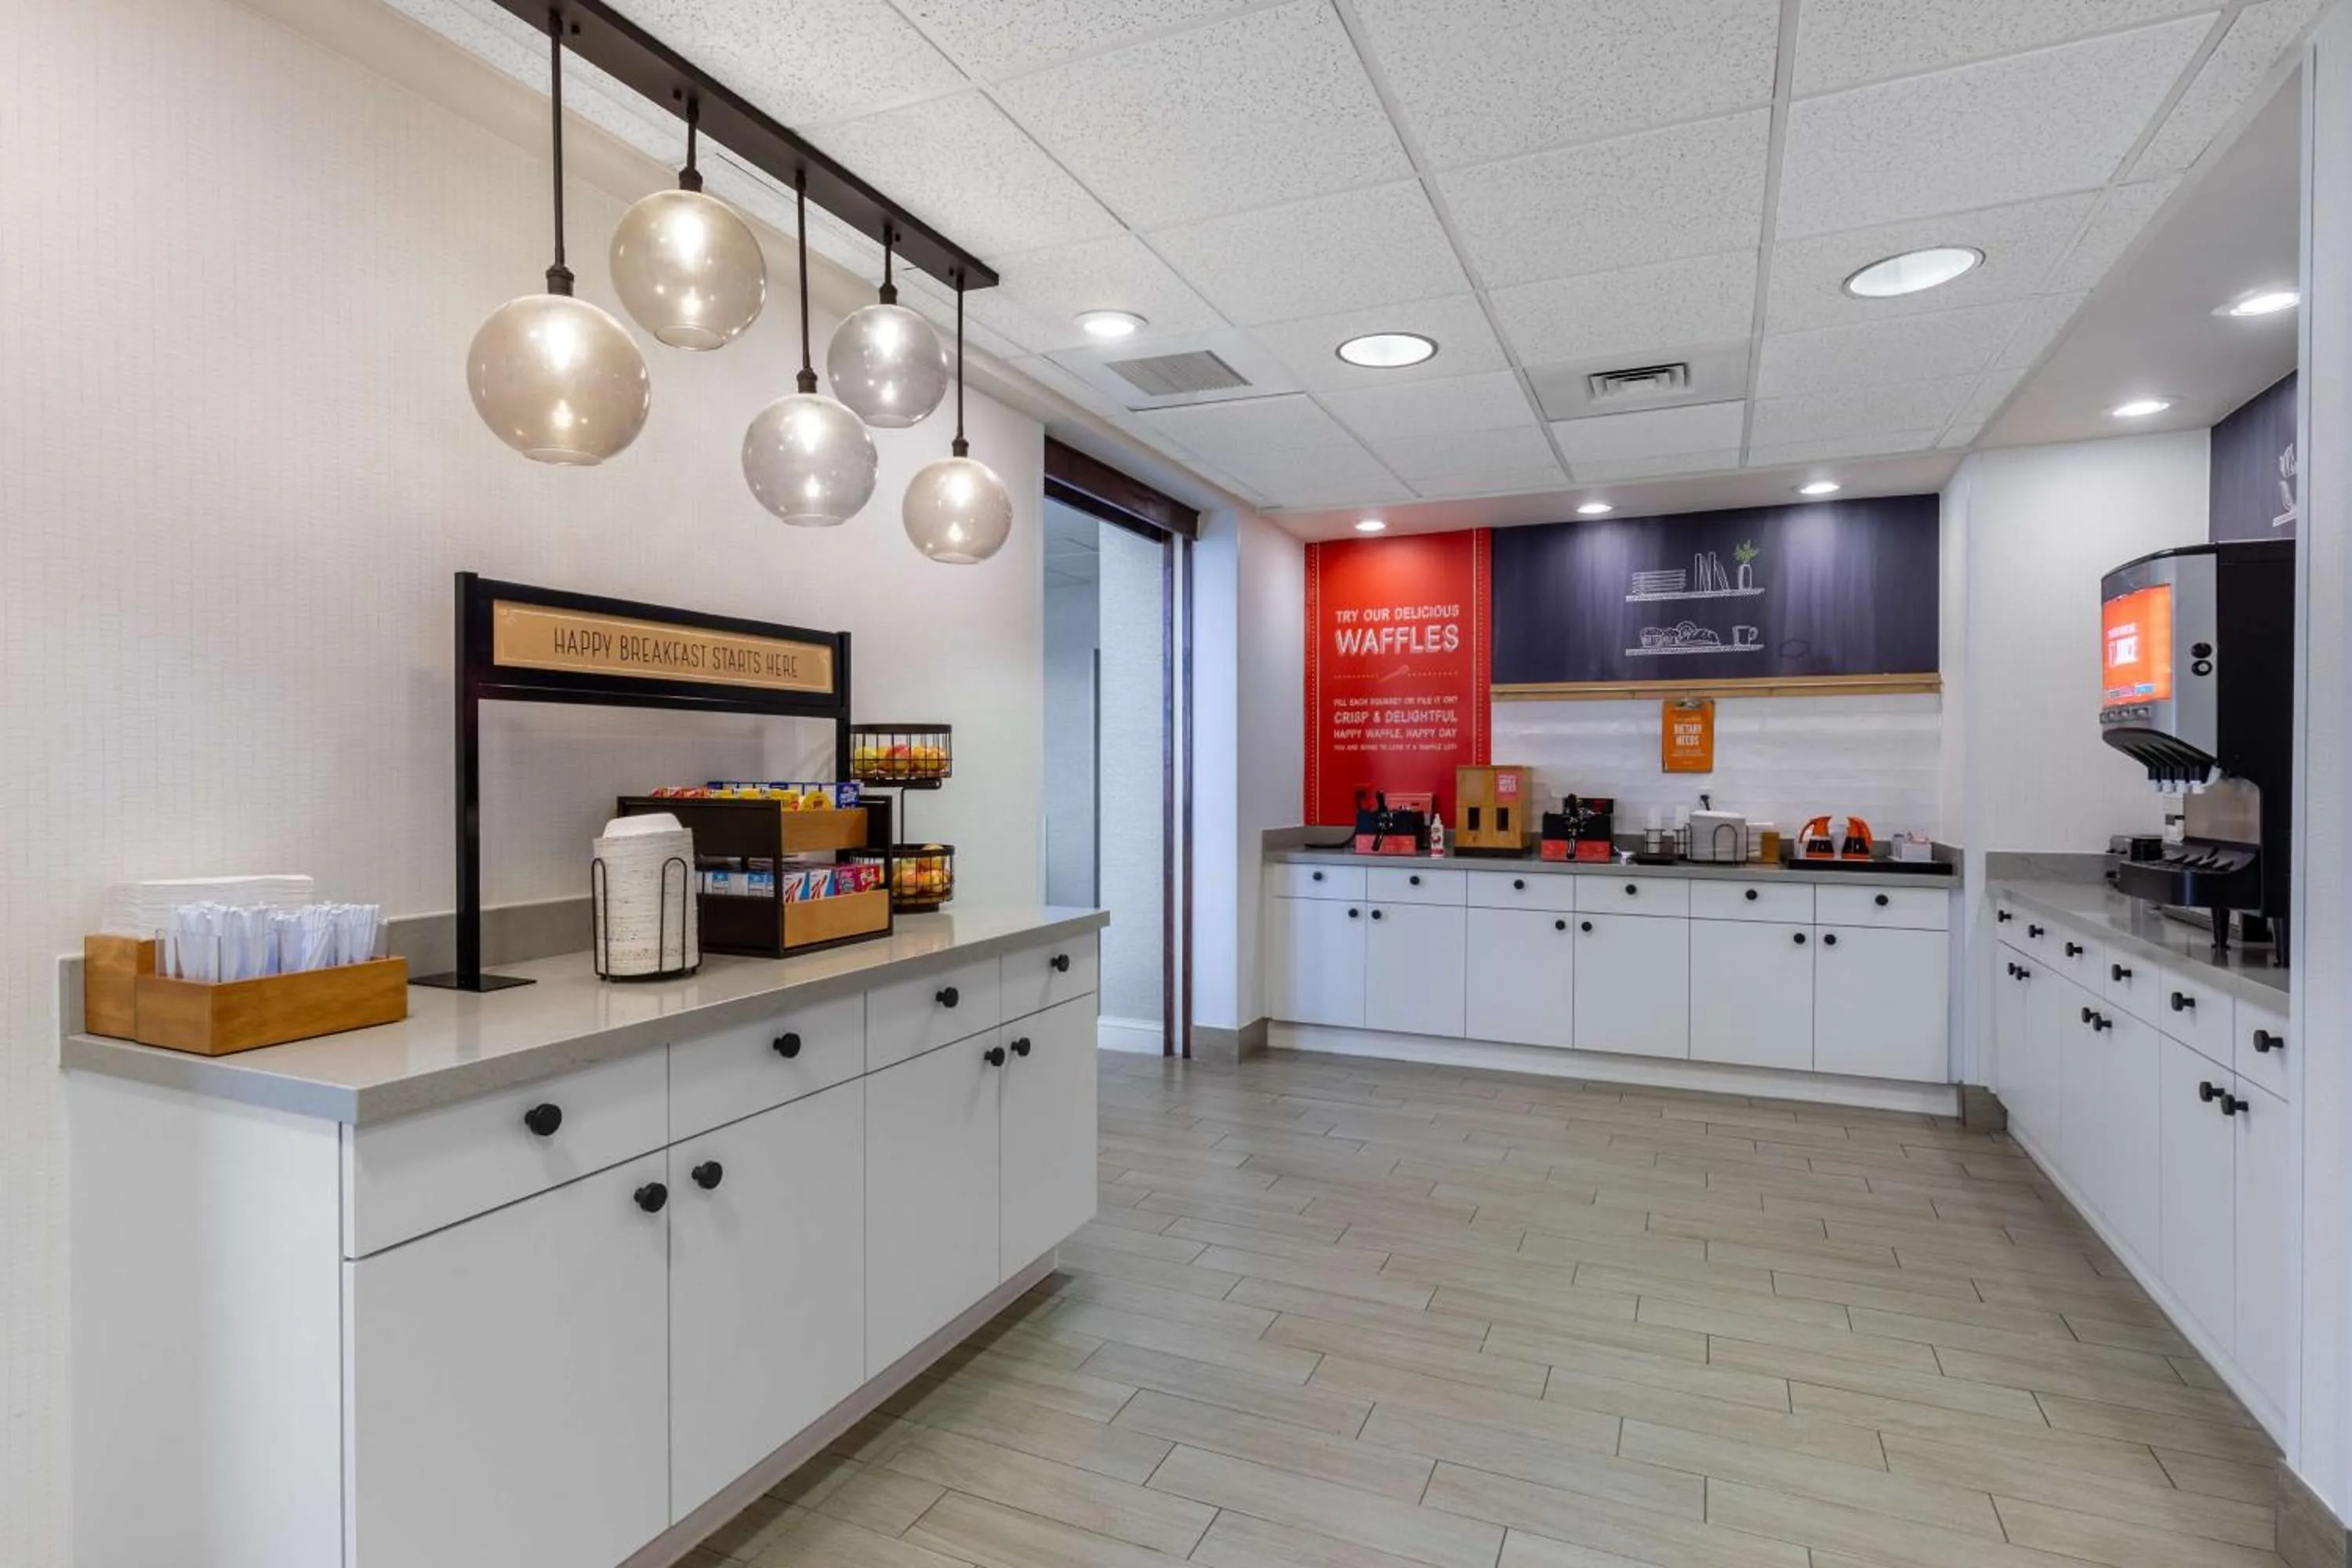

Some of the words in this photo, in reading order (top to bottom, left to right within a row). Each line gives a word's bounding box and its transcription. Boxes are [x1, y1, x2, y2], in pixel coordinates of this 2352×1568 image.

[1336, 609, 1359, 623] TRY
[1363, 608, 1390, 622] OUR
[1395, 604, 1459, 621] DELICIOUS
[1335, 624, 1459, 656] WAFFLES
[554, 627, 612, 659] HAPPY
[619, 634, 708, 668] BREAKFAST
[712, 647, 761, 674] STARTS
[766, 652, 798, 678] HERE
[1334, 710, 1369, 724] CRISP
[1372, 710, 1381, 724] &
[1385, 709, 1458, 724] DELIGHTFUL
[1334, 728, 1362, 739] HAPPY
[1406, 728, 1436, 739] HAPPY
[1439, 727, 1458, 739] DAY
